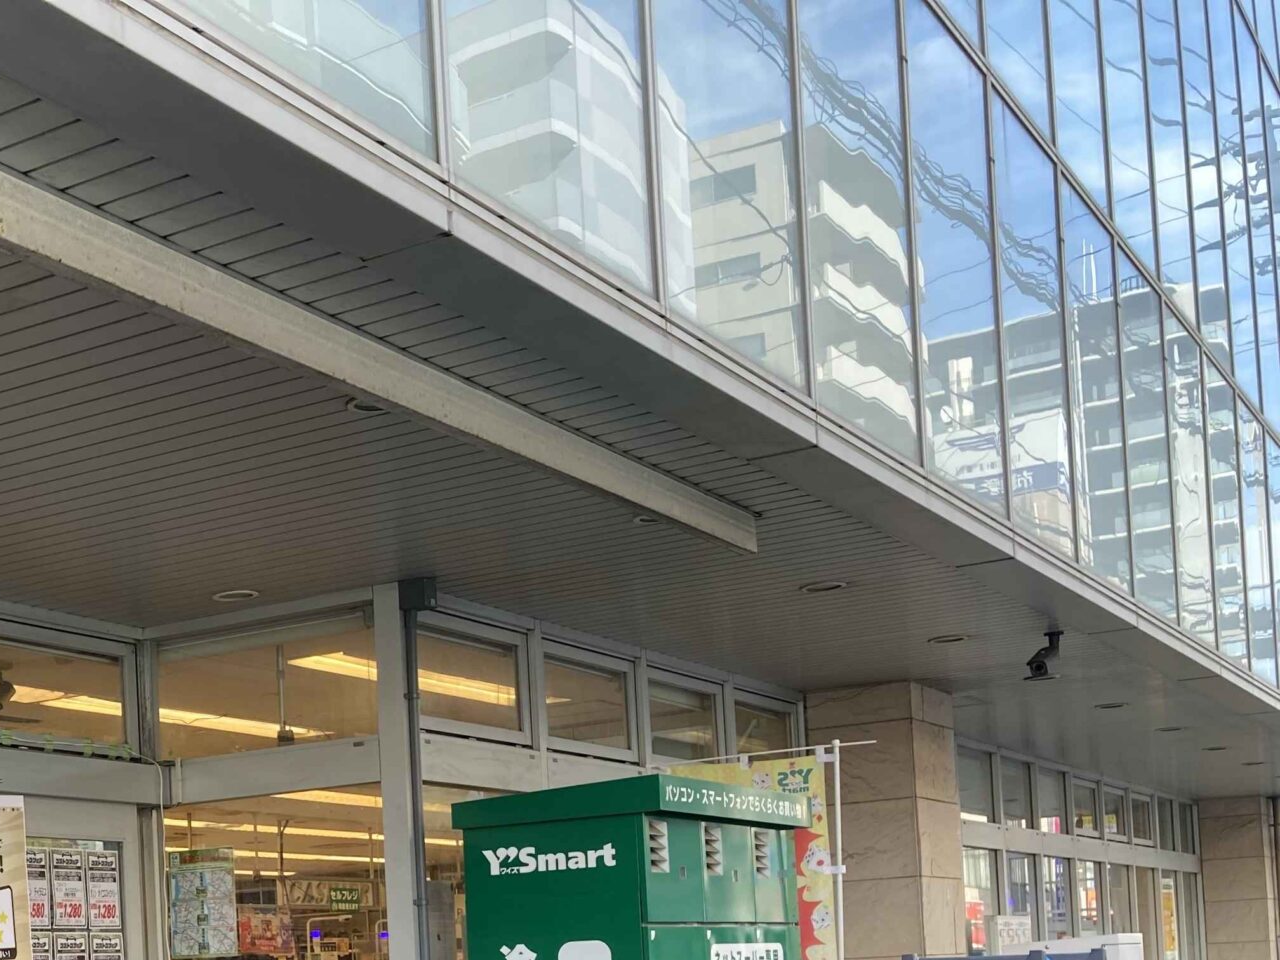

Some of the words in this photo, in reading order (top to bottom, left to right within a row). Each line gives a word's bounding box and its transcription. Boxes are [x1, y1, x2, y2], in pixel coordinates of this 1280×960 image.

[500, 867, 520, 875] ワイズ
[289, 881, 372, 905] CASR
[331, 889, 360, 901] セルフレジ
